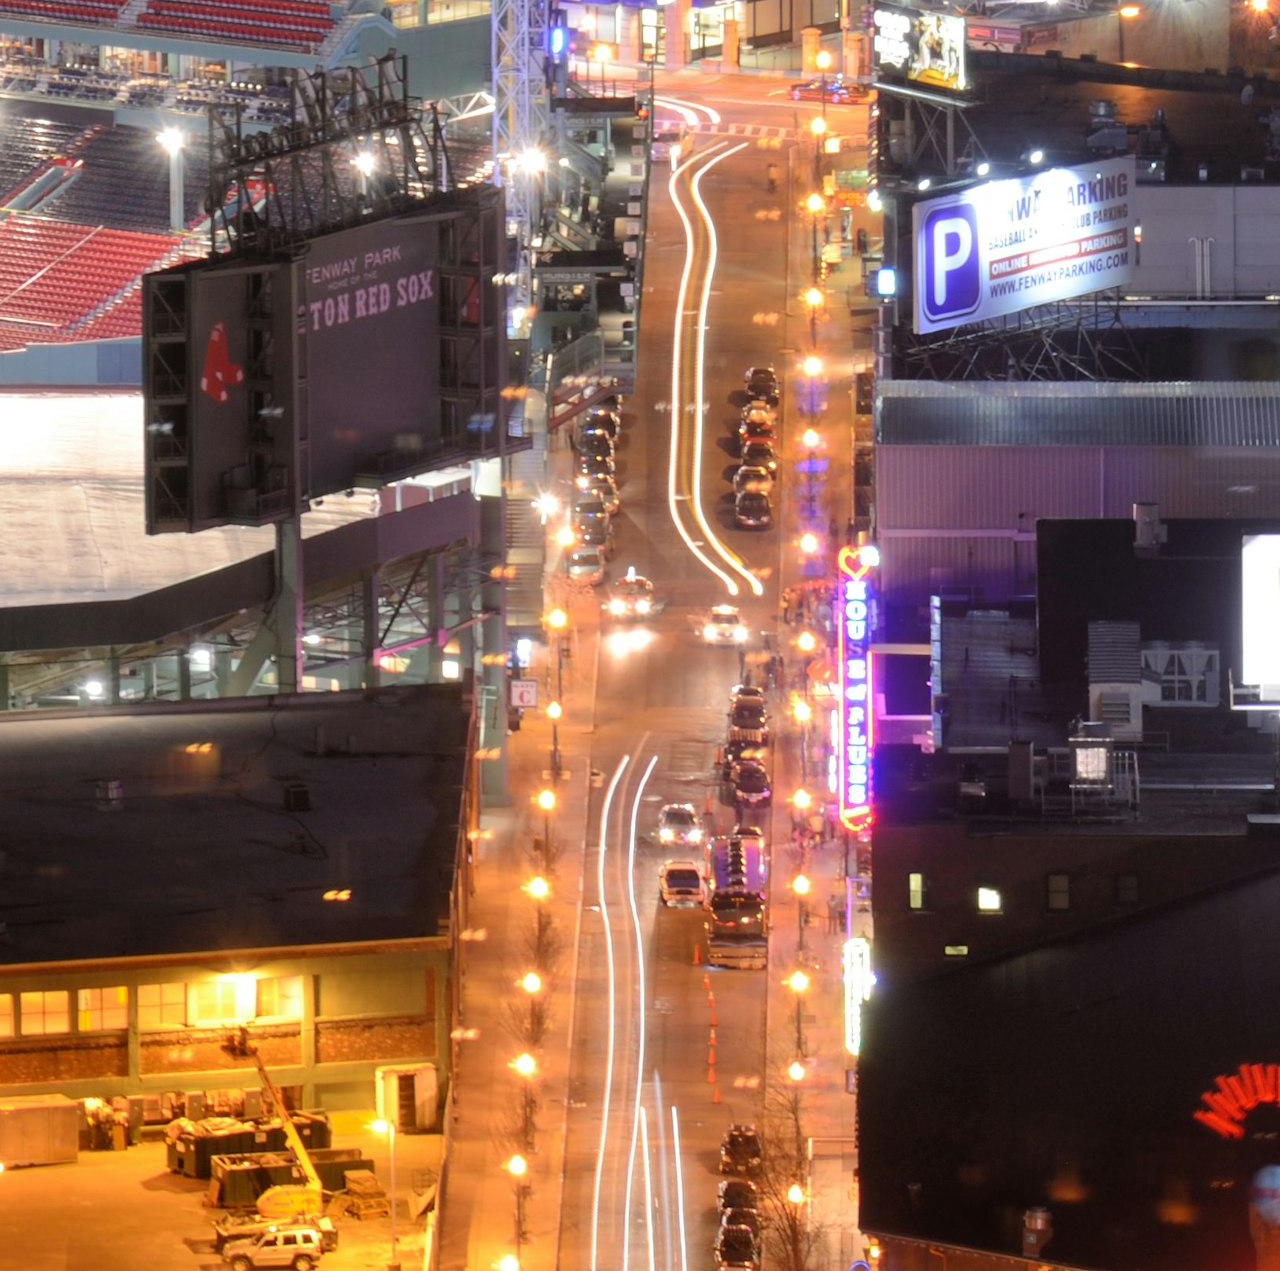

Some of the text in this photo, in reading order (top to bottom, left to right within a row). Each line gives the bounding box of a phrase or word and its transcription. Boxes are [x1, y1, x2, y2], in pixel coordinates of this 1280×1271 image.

[1067, 172, 1128, 207] ARKING
[1092, 203, 1128, 226] PARKING
[364, 246, 402, 269] PARK
[933, 217, 973, 306] P
[991, 254, 1028, 275] ONLINE
[1080, 231, 1124, 253] PARKING
[989, 251, 1129, 298] WWW.FENWAYPARKING.COM
[355, 282, 390, 319] RED
[396, 270, 433, 307] SOX
[518, 690, 531, 704] C
